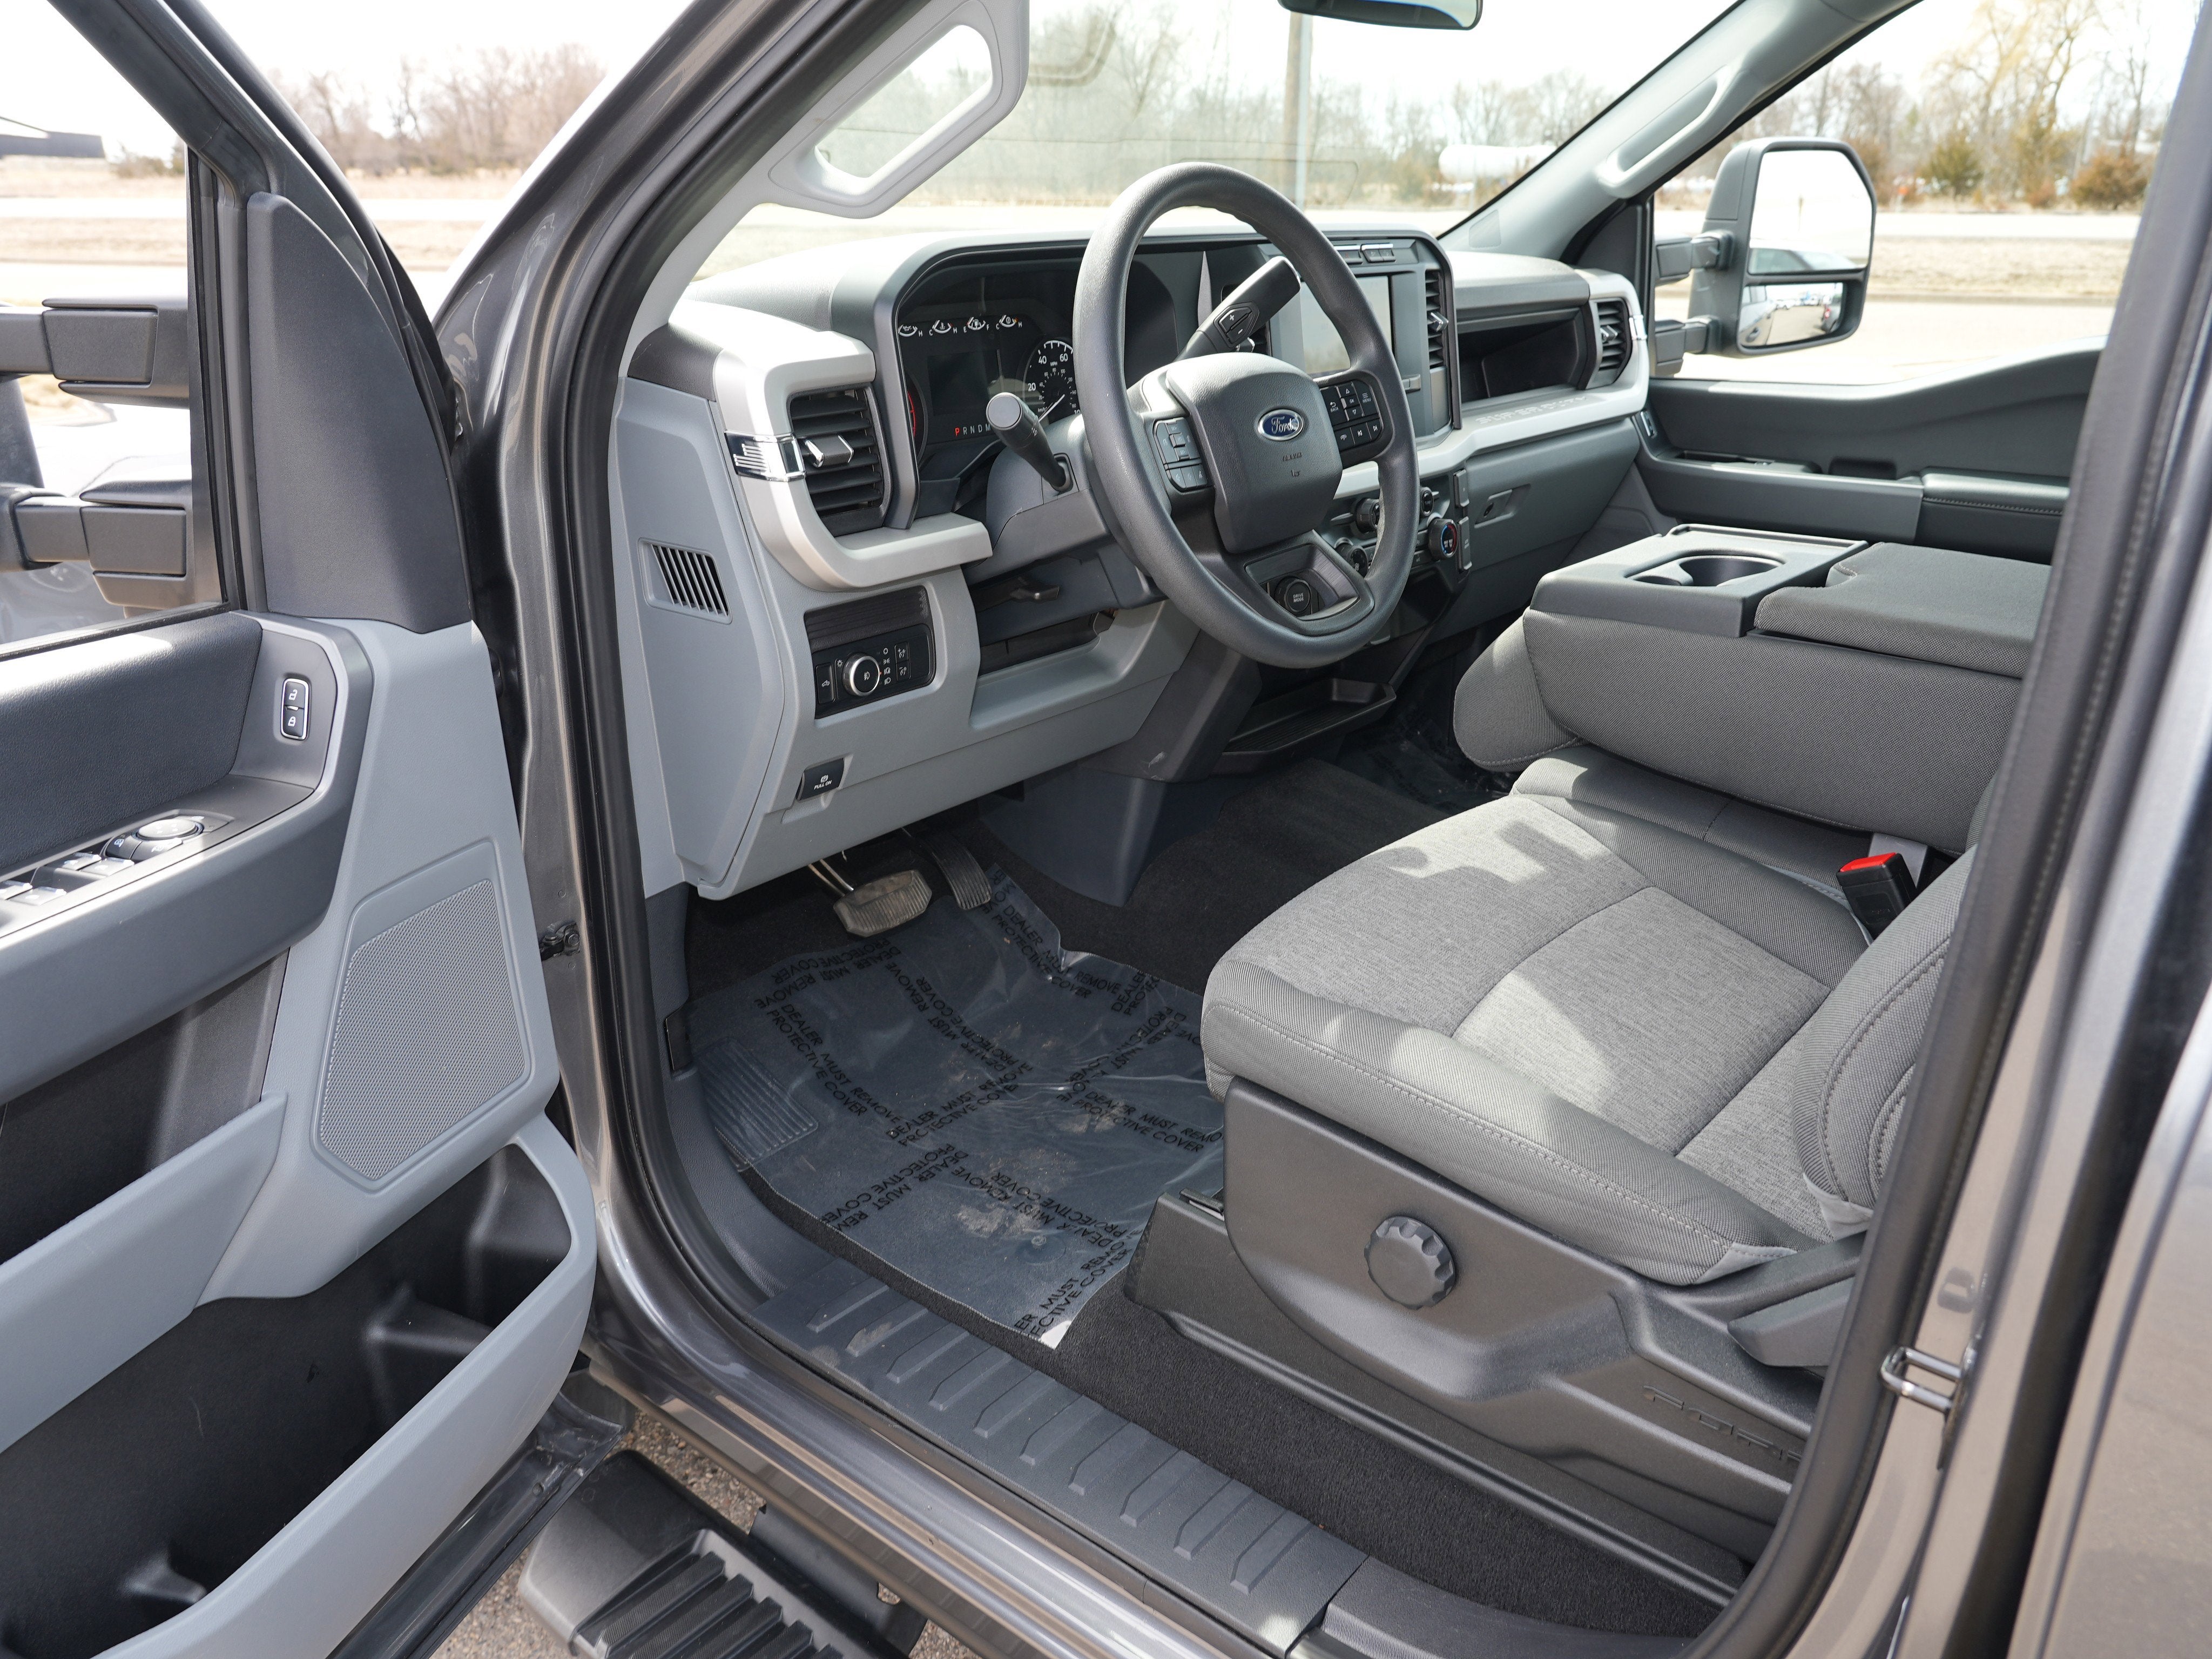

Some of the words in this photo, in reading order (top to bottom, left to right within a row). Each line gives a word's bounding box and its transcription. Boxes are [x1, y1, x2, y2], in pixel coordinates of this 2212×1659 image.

[1038, 355, 1047, 365] 40
[1060, 353, 1068, 362] 60
[1028, 382, 1036, 392] 20
[955, 427, 960, 436] P
[963, 426, 967, 435] R
[970, 425, 975, 434] N
[978, 424, 982, 433] D
[986, 423, 991, 432] M
[1271, 416, 1294, 434] Ford
[854, 945, 902, 970] DEALER
[992, 915, 1052, 974] PROTECTIVE
[1051, 976, 1092, 999] COVER
[1003, 904, 1043, 946] DEALER
[1074, 970, 1122, 995] REMOVE
[771, 959, 819, 985] COVER
[885, 961, 930, 1013] REMOVE
[754, 973, 817, 1009] REMOVE
[916, 976, 954, 1016] COVER
[927, 1016, 960, 1041] MUST
[950, 1015, 1020, 1067] PROTECTIVE
[766, 1009, 828, 1080] PROTECTIVE
[824, 1081, 868, 1116] COVER
[781, 1003, 823, 1047] DEALER
[820, 1053, 852, 1086] MUST
[850, 1086, 901, 1124] REMOVE
[886, 1110, 939, 1139] DEALER
[940, 1090, 976, 1112] MUST
[898, 1102, 978, 1147] PROTECTIVE
[1138, 1112, 1179, 1130] MUST
[1180, 1127, 1224, 1144] REMO
[1152, 1131, 1204, 1152] COVER
[870, 1143, 956, 1194] PROTECTIVE
[913, 1150, 969, 1182] DEALER
[872, 1183, 913, 1211] MUST
[951, 1166, 1012, 1203] REMOVE
[990, 1171, 1042, 1202] COVER
[1012, 1201, 1055, 1225] MUST
[1041, 1197, 1128, 1238] PROTECTIVE
[1080, 1248, 1133, 1288] COVER
[1040, 1277, 1080, 1310] MUST
